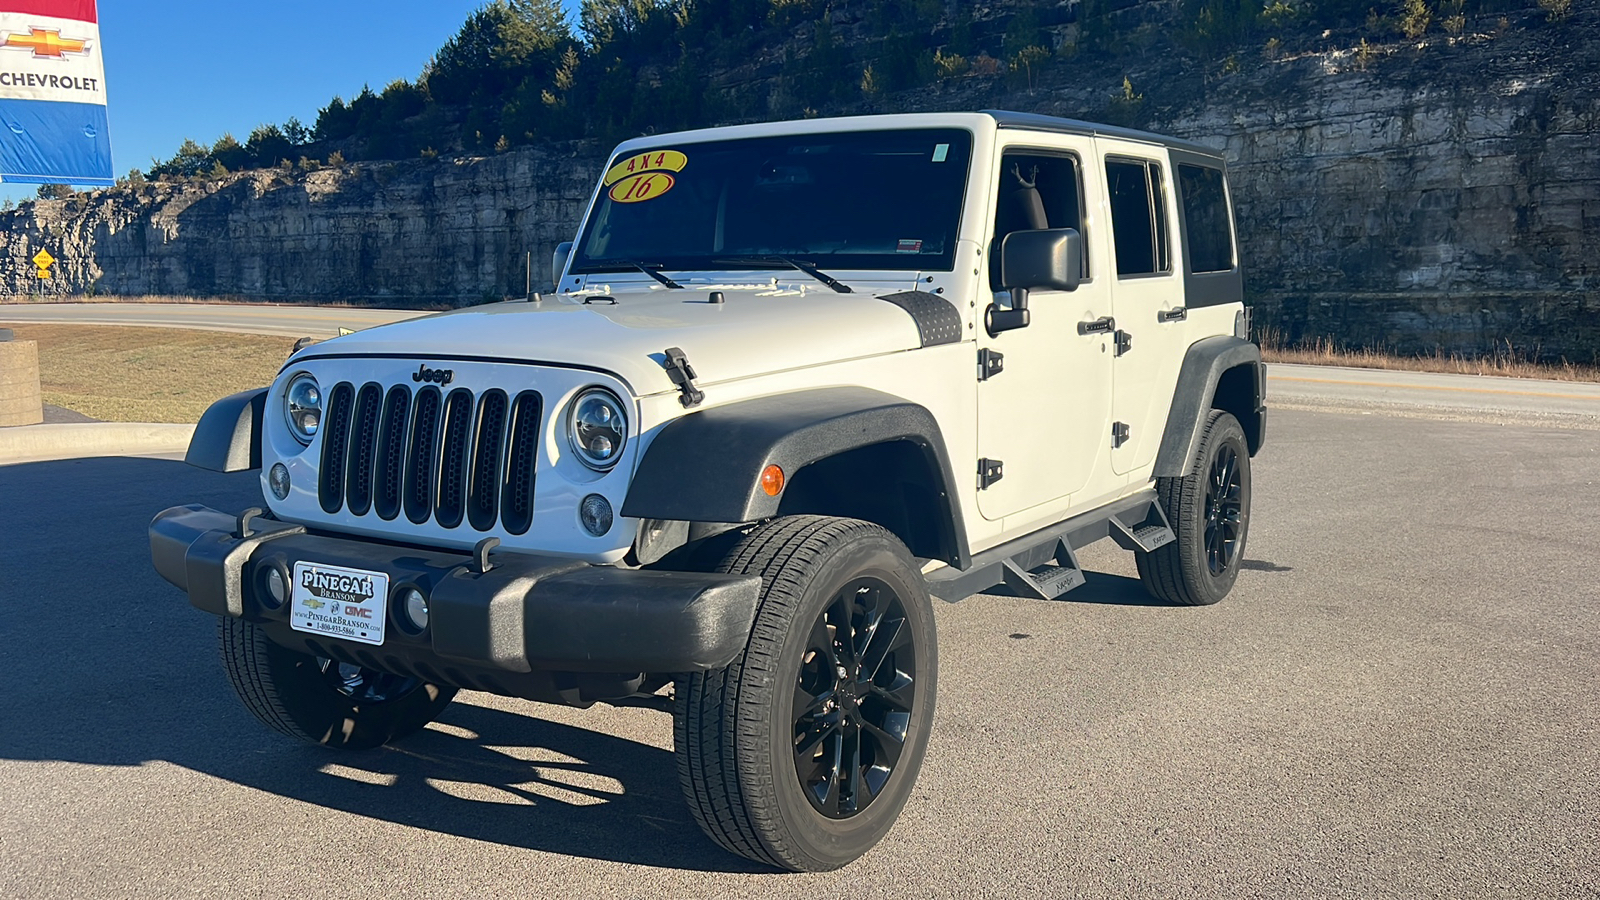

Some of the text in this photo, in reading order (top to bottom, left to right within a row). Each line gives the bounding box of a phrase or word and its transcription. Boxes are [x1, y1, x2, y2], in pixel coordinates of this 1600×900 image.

[0, 72, 98, 91] CHEVROLET
[620, 174, 659, 200] 16
[412, 363, 454, 387] Jeep
[303, 571, 373, 597] PINEGAR
[320, 588, 356, 602] BRANSON
[345, 606, 372, 619] GMC
[316, 622, 355, 635] 1-800-933-5866
